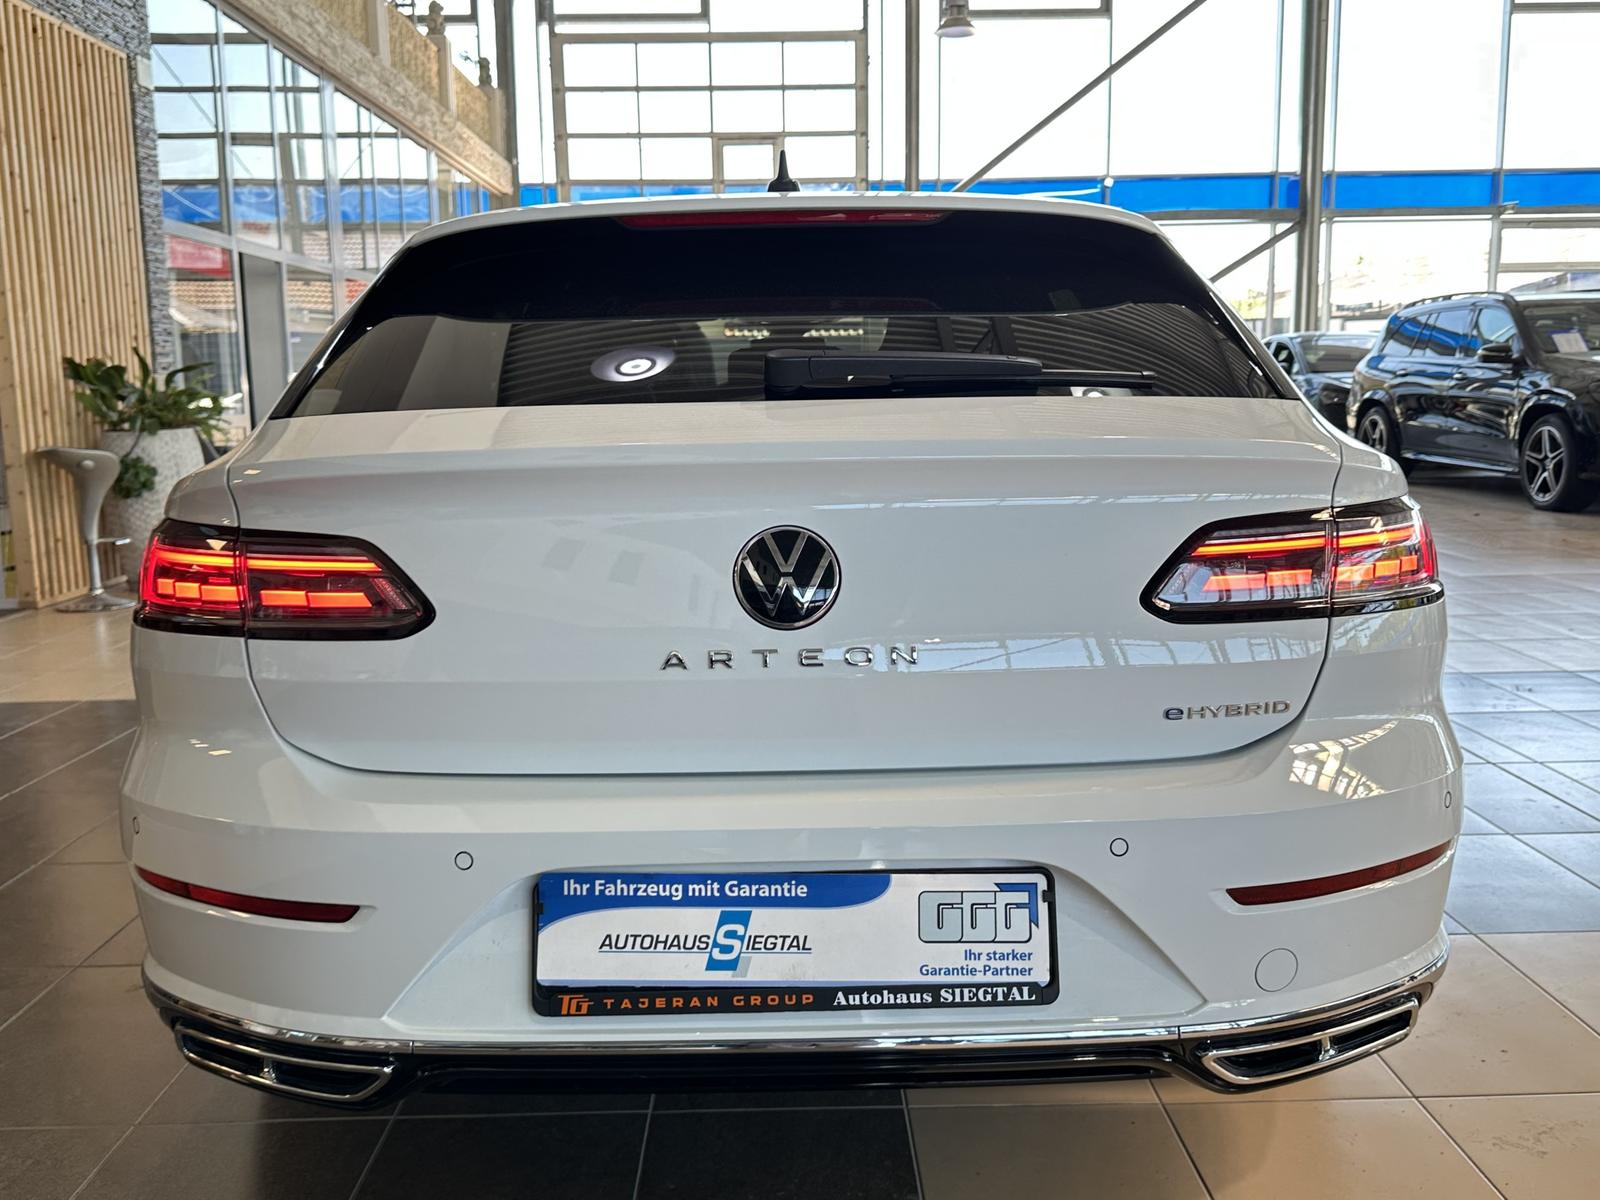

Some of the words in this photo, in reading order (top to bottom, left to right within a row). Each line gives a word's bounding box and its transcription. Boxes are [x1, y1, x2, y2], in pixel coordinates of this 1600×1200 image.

[660, 646, 919, 670] ARTEON
[1163, 700, 1291, 721] eHYBRID
[563, 880, 589, 896] Ihr
[595, 880, 683, 900] Fahrzeug
[688, 881, 720, 896] mit
[724, 881, 808, 897] Garantie
[599, 934, 711, 951] AUTOHAUS
[964, 949, 983, 961] Ihr
[986, 949, 1033, 961] starker
[919, 964, 1033, 977] Garantie-Partner
[604, 996, 719, 1009] TAJERAN
[732, 994, 815, 1007] GROUP
[832, 990, 932, 1006] Autohaus
[940, 986, 1036, 1002] SIEGTAL
